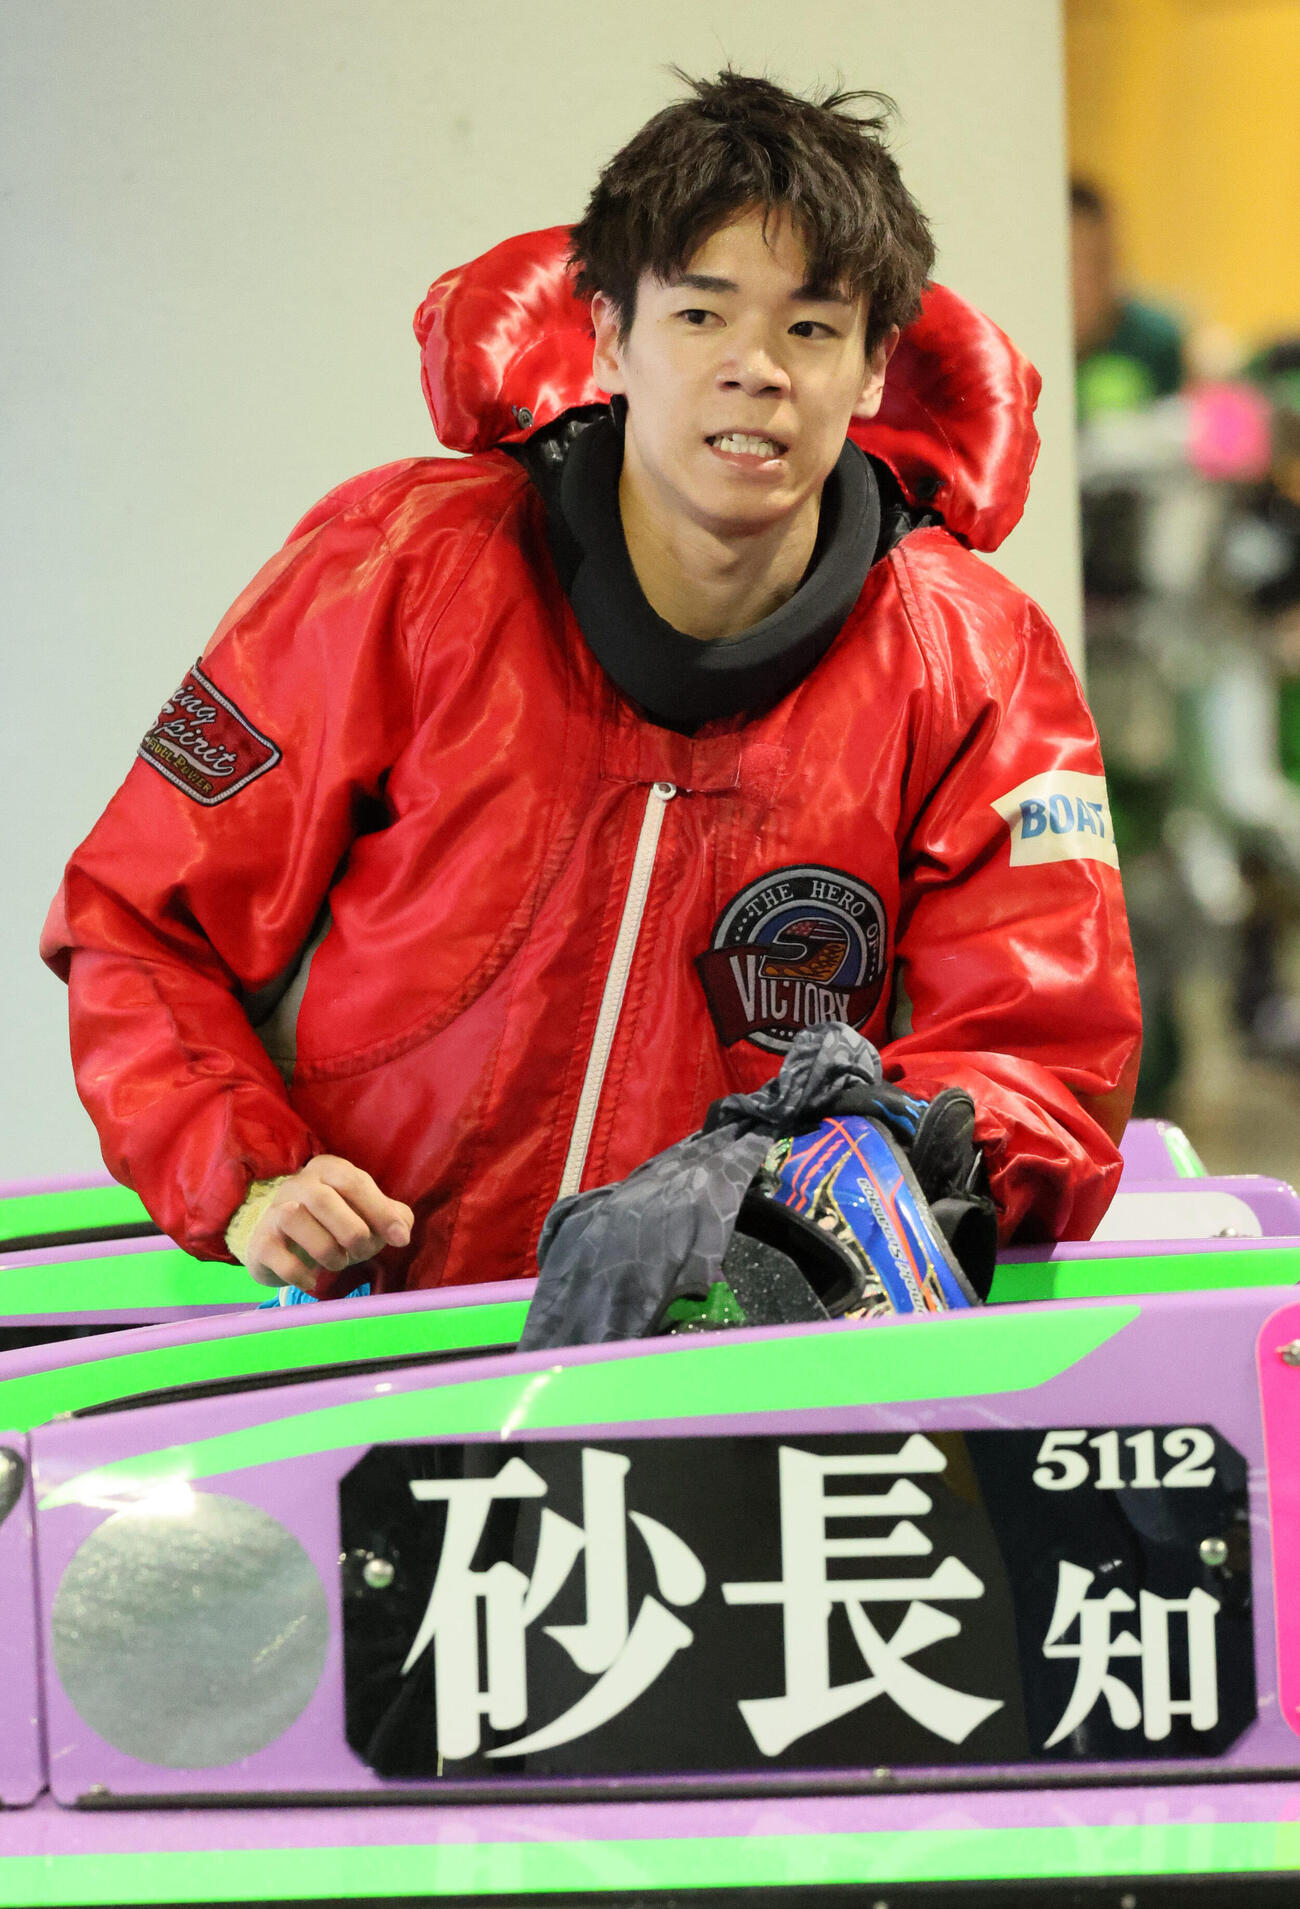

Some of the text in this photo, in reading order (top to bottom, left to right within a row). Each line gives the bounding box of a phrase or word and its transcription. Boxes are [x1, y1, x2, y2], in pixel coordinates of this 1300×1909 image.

[171, 685, 217, 726] ing
[1019, 794, 1105, 840] BOAT
[745, 883, 795, 917] THE
[810, 880, 866, 917] HERO
[729, 954, 850, 1028] VICTORY
[1033, 1428, 1216, 1491] 5112
[403, 1434, 1221, 1760] 砂長 知
